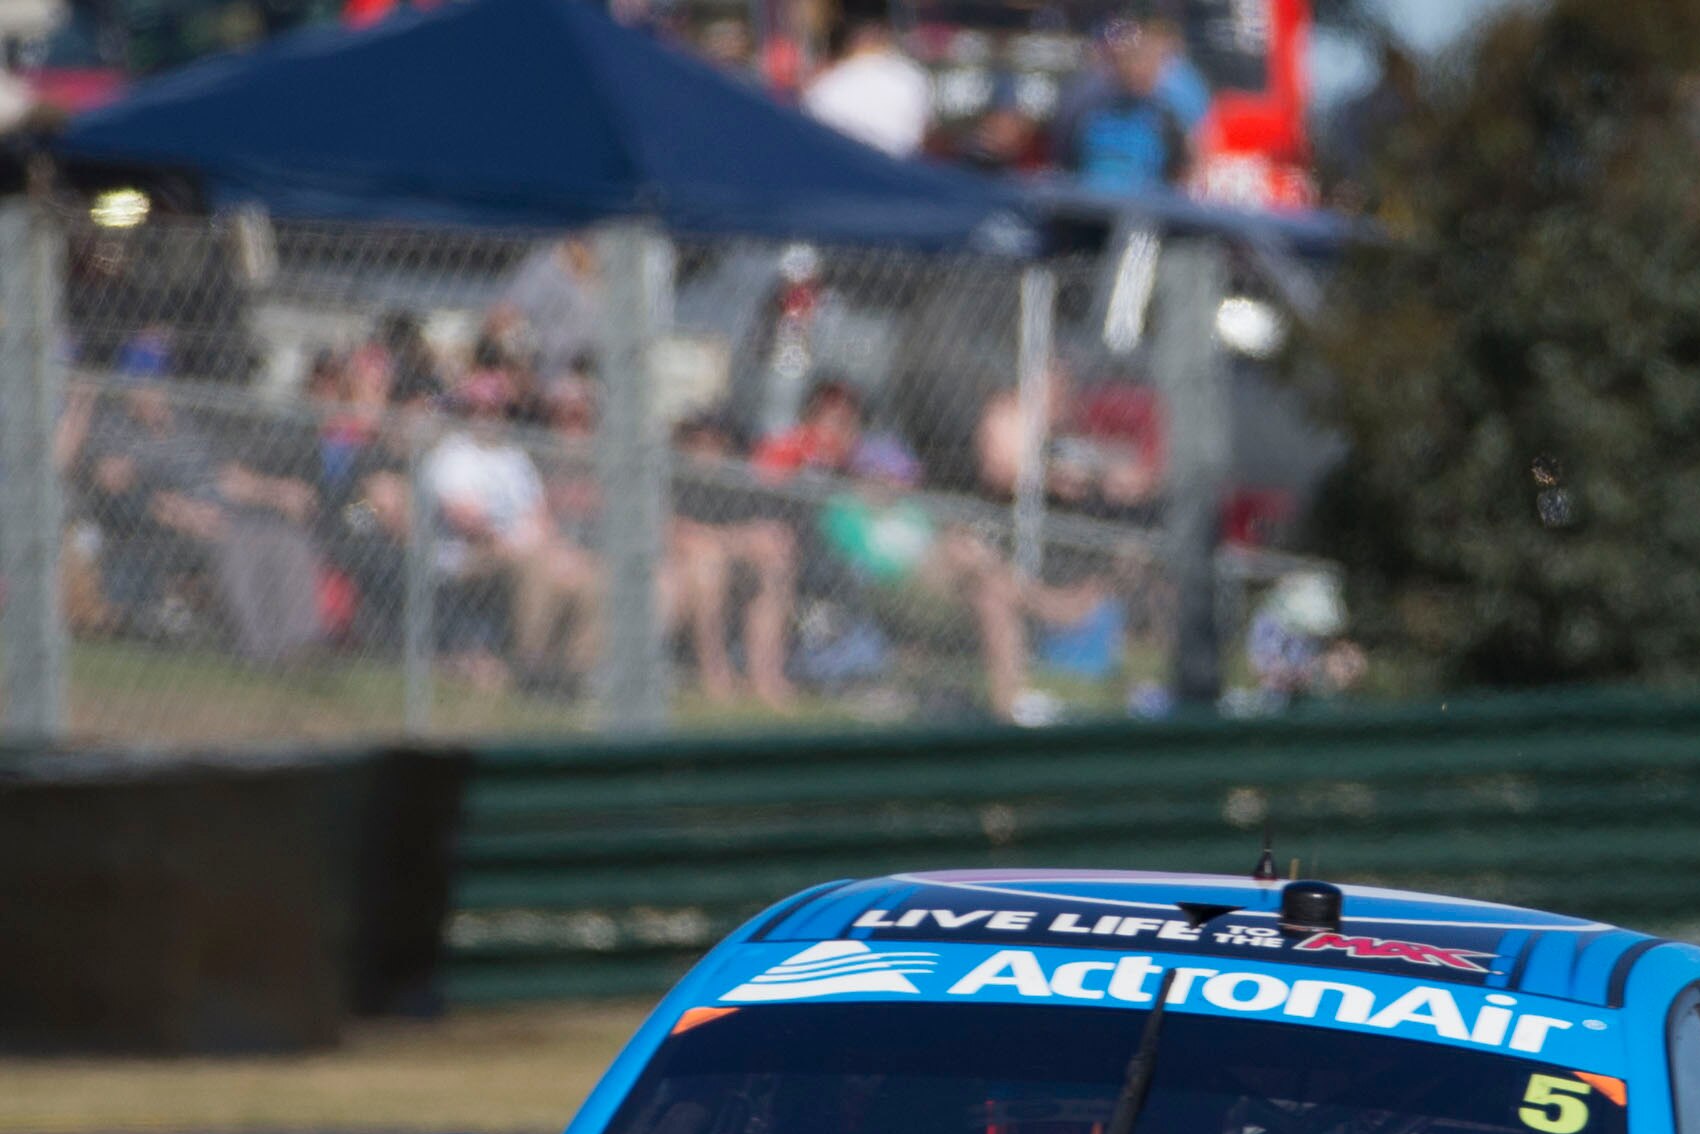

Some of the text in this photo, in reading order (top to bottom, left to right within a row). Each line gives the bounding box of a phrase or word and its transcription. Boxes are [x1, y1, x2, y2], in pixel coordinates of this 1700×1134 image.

[853, 908, 1204, 941] LIVE LIFE
[1226, 924, 1279, 939] TO
[1212, 931, 1501, 976] THE MAX
[947, 950, 1574, 1053] ActronAir
[1518, 1073, 1593, 1134] 5
